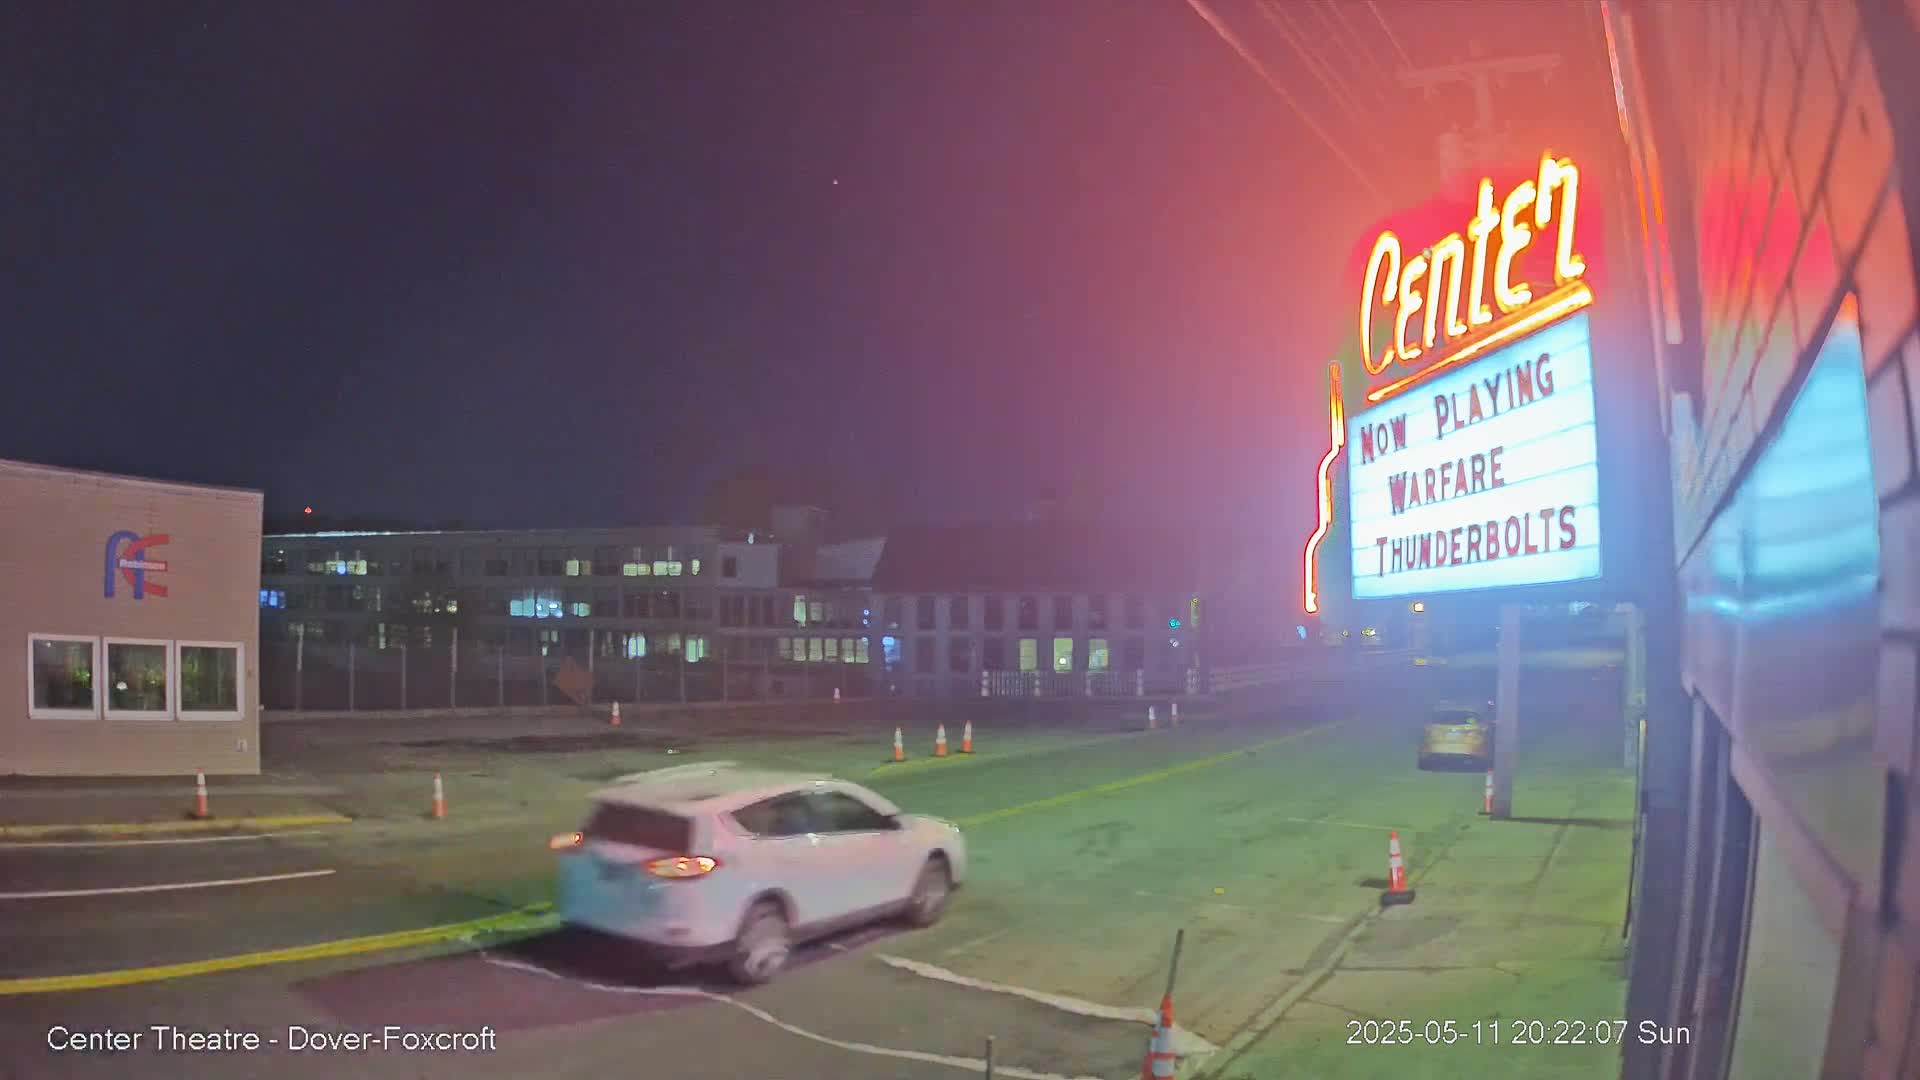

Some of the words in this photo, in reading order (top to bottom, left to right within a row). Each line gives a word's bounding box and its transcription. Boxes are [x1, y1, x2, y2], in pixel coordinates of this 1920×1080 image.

[1361, 152, 1586, 375] Center
[1360, 413, 1408, 464] NOW
[1435, 353, 1555, 439] PLAYING
[1389, 446, 1504, 515] WARFARE
[1376, 505, 1577, 577] THUNDERBOLTS
